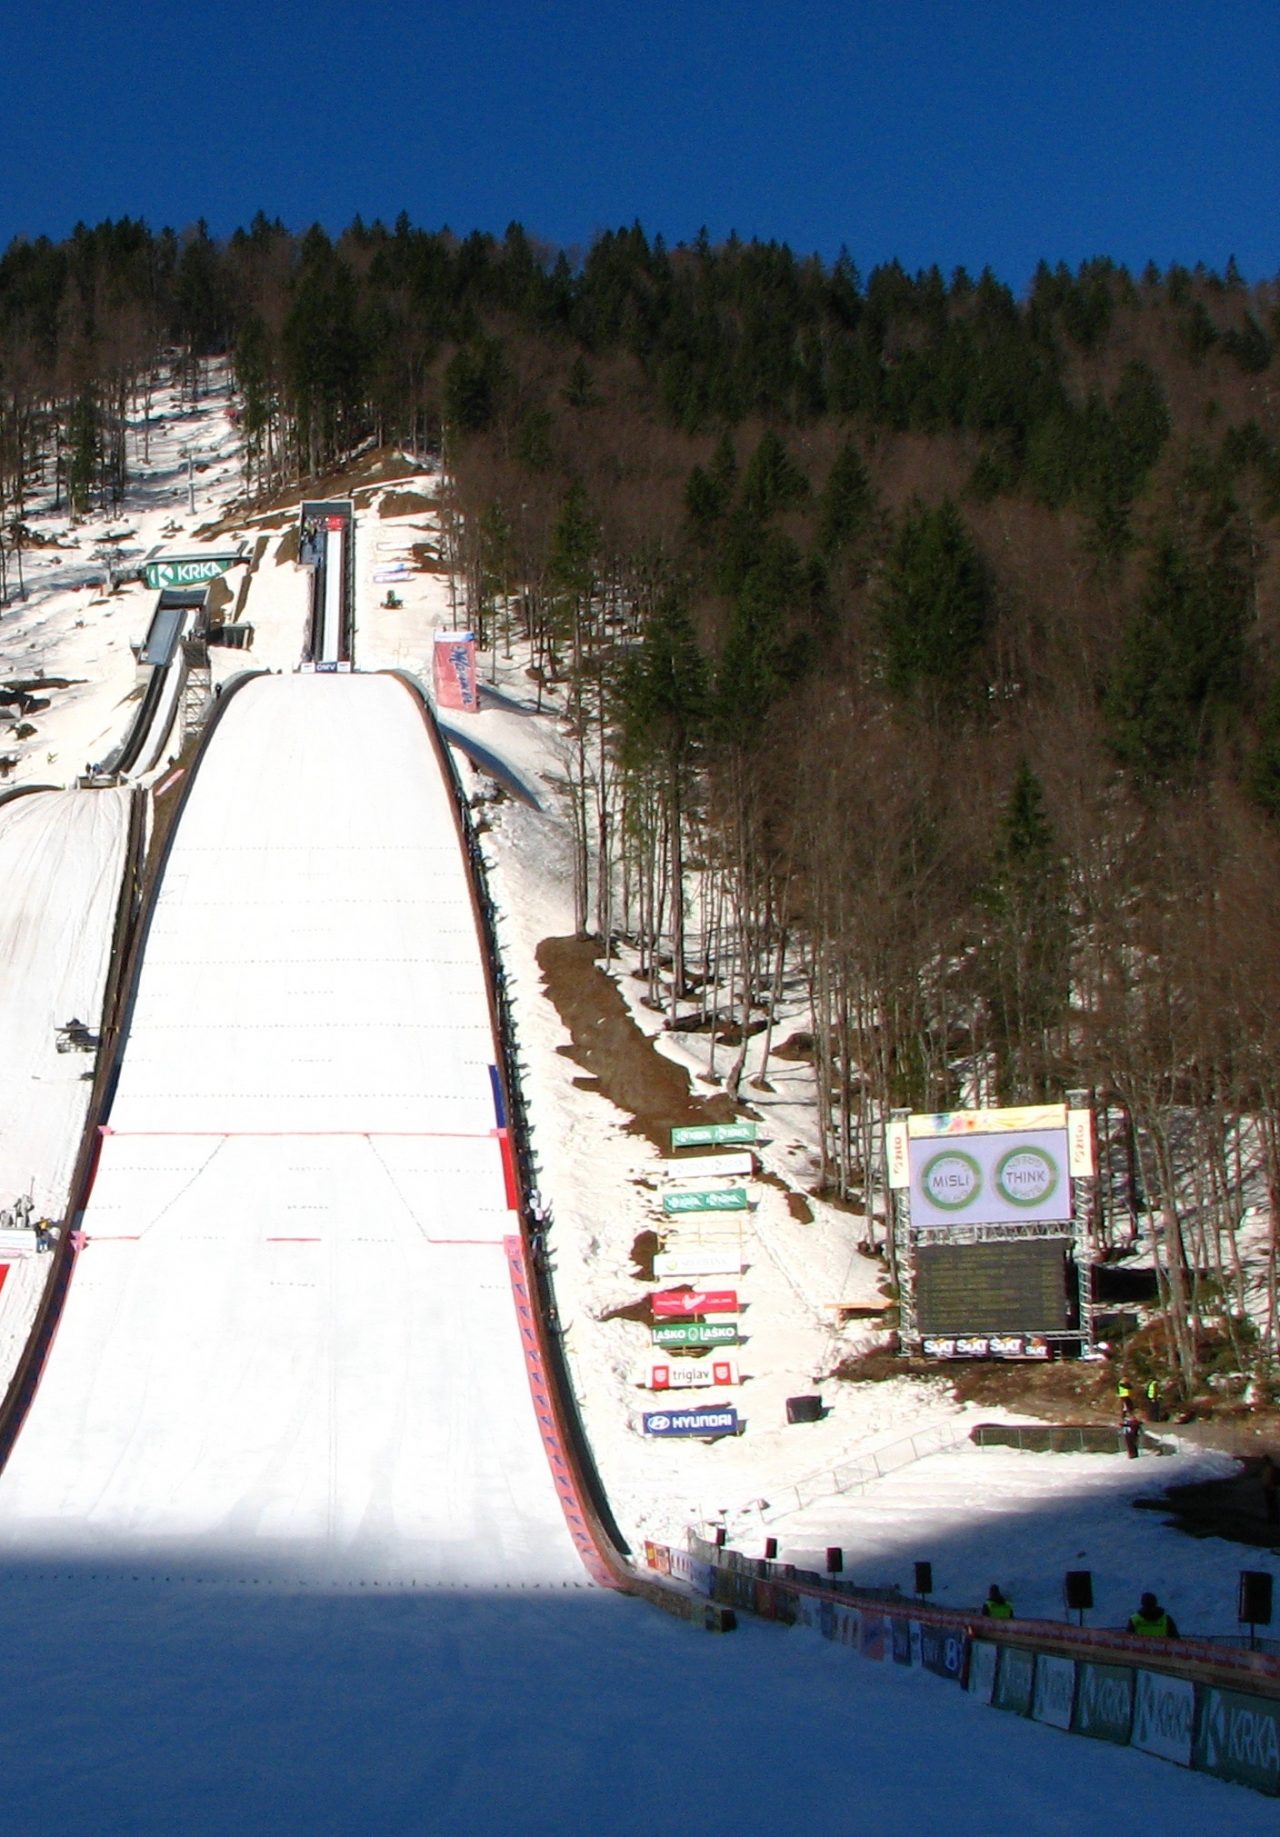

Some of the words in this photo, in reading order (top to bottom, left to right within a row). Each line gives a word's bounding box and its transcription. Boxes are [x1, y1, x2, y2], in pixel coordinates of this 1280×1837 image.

[177, 561, 223, 579] KRKA
[932, 1173, 969, 1188] MISLI
[1006, 1170, 1046, 1184] THINK
[673, 1369, 710, 1384] triglav
[672, 1414, 732, 1429] HYUNDAI
[1228, 1706, 1280, 1772] KRKA
